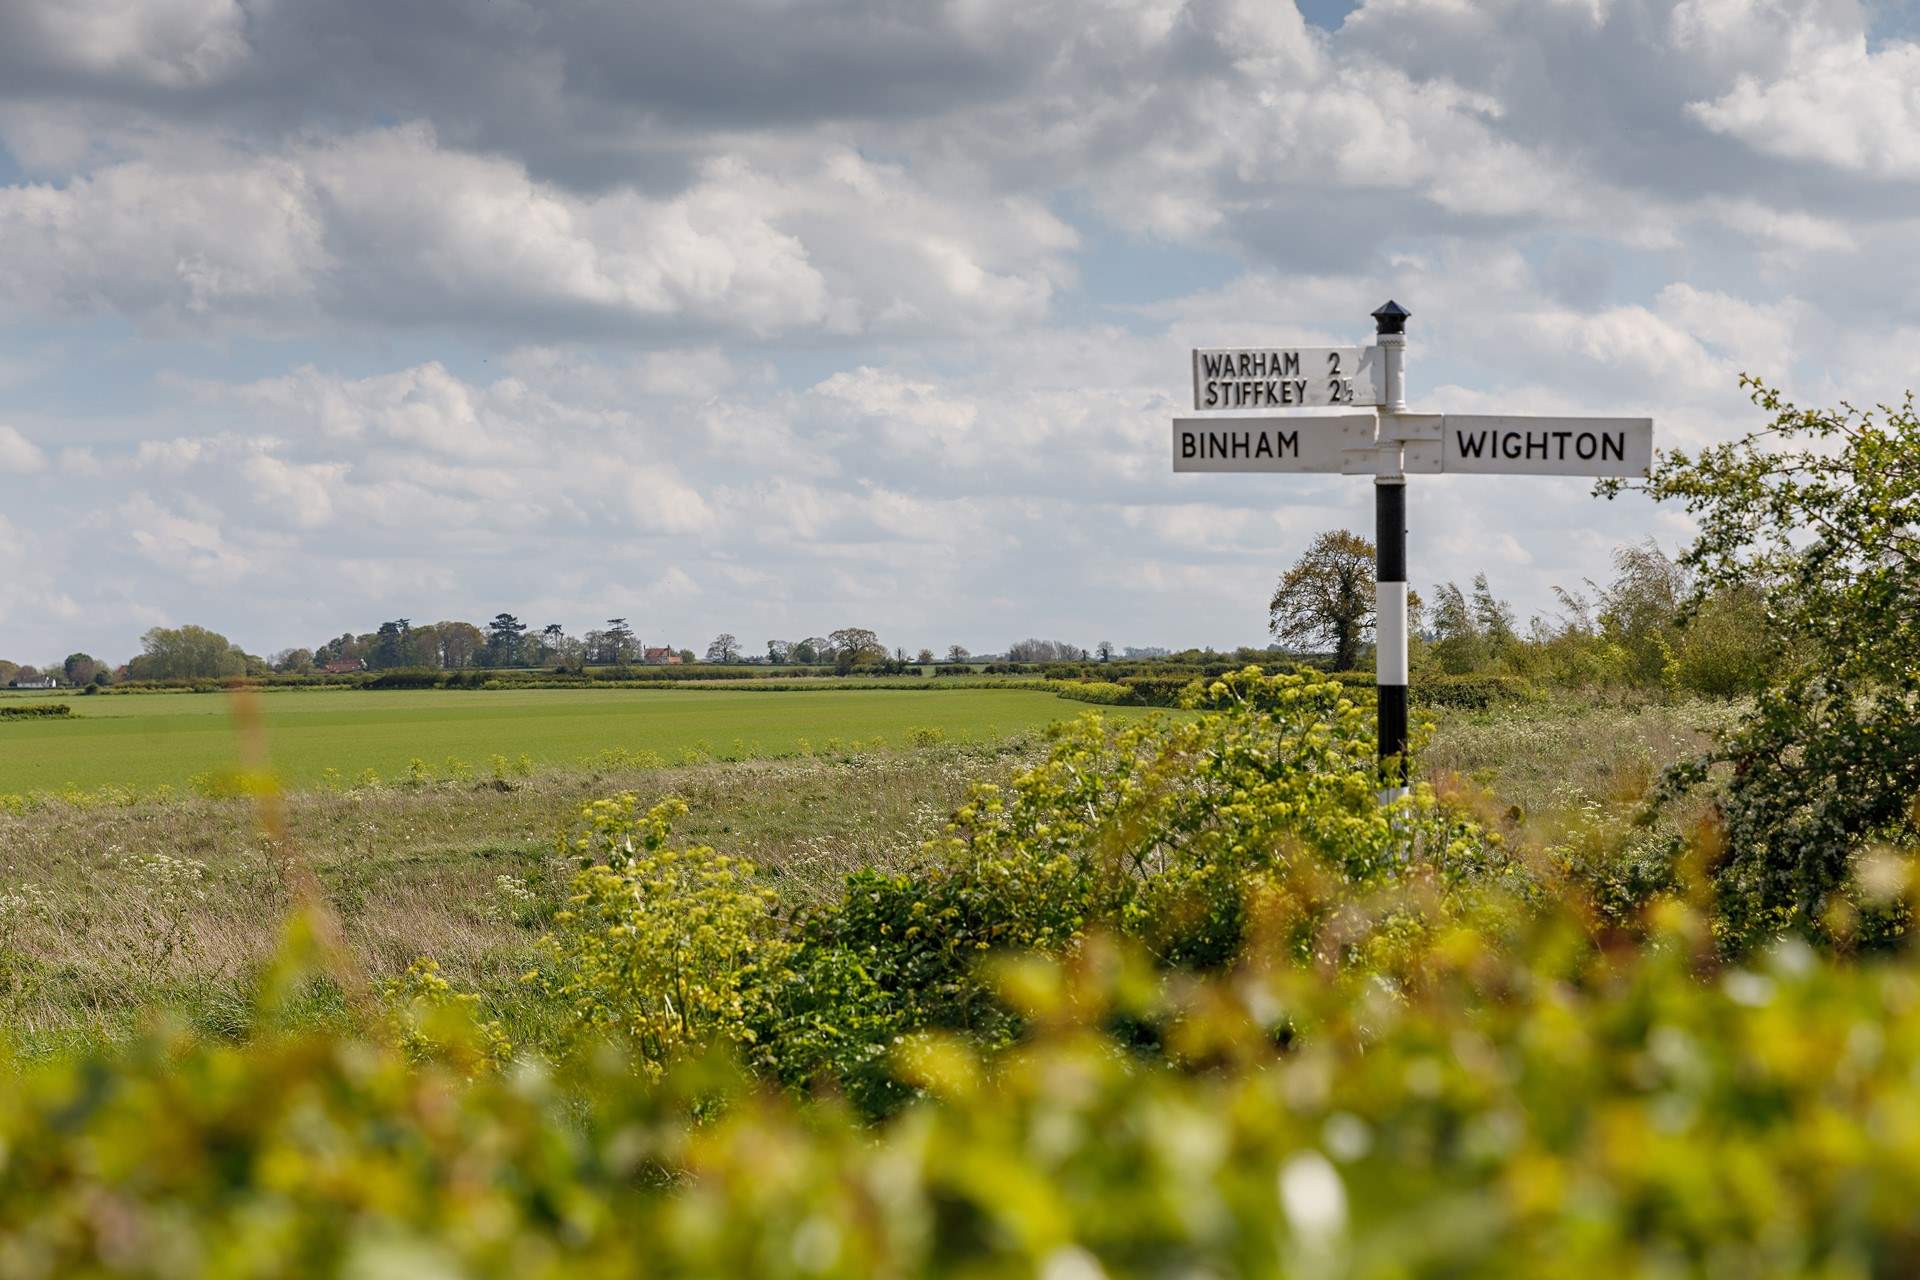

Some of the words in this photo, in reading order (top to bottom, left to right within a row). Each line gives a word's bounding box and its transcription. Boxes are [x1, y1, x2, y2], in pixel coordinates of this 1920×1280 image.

[1203, 352, 1300, 377] WARHAM
[1328, 352, 1341, 376] 2
[1206, 380, 1308, 406] STIFFKEY
[1182, 431, 1299, 459] BINHAM
[1457, 430, 1625, 462] WIGHTON
